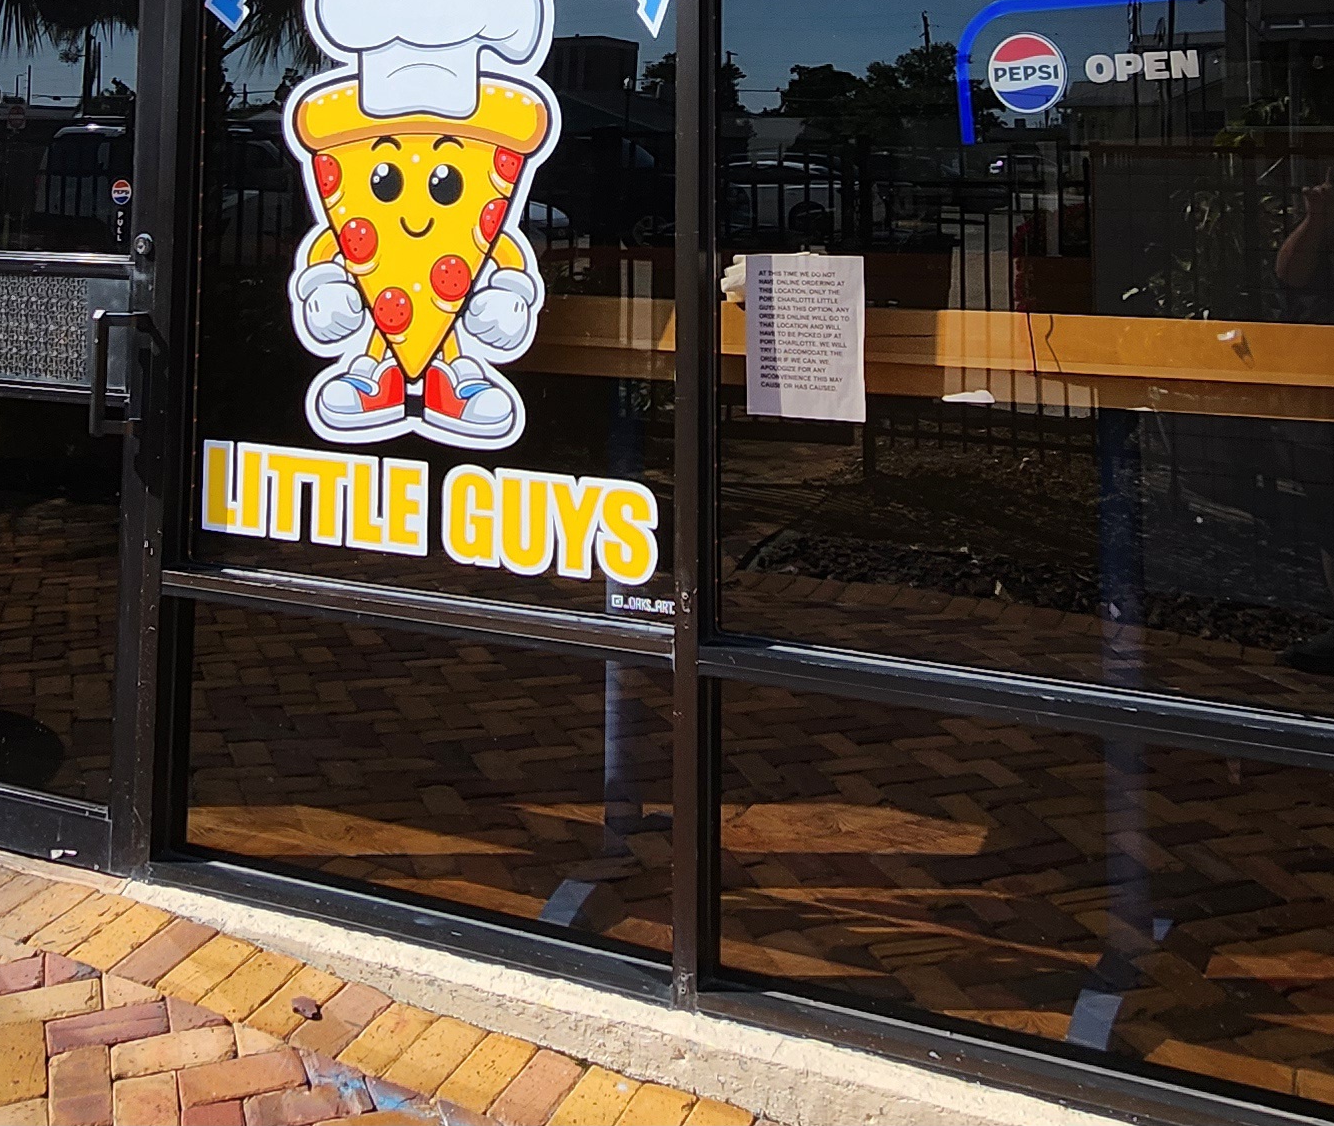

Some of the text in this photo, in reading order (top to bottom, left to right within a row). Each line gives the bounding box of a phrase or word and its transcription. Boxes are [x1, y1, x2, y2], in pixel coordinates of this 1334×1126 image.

[993, 49, 1200, 84] PEPSI OPEN
[116, 210, 124, 242] PULL
[202, 439, 659, 586] LITTLE GUYS
